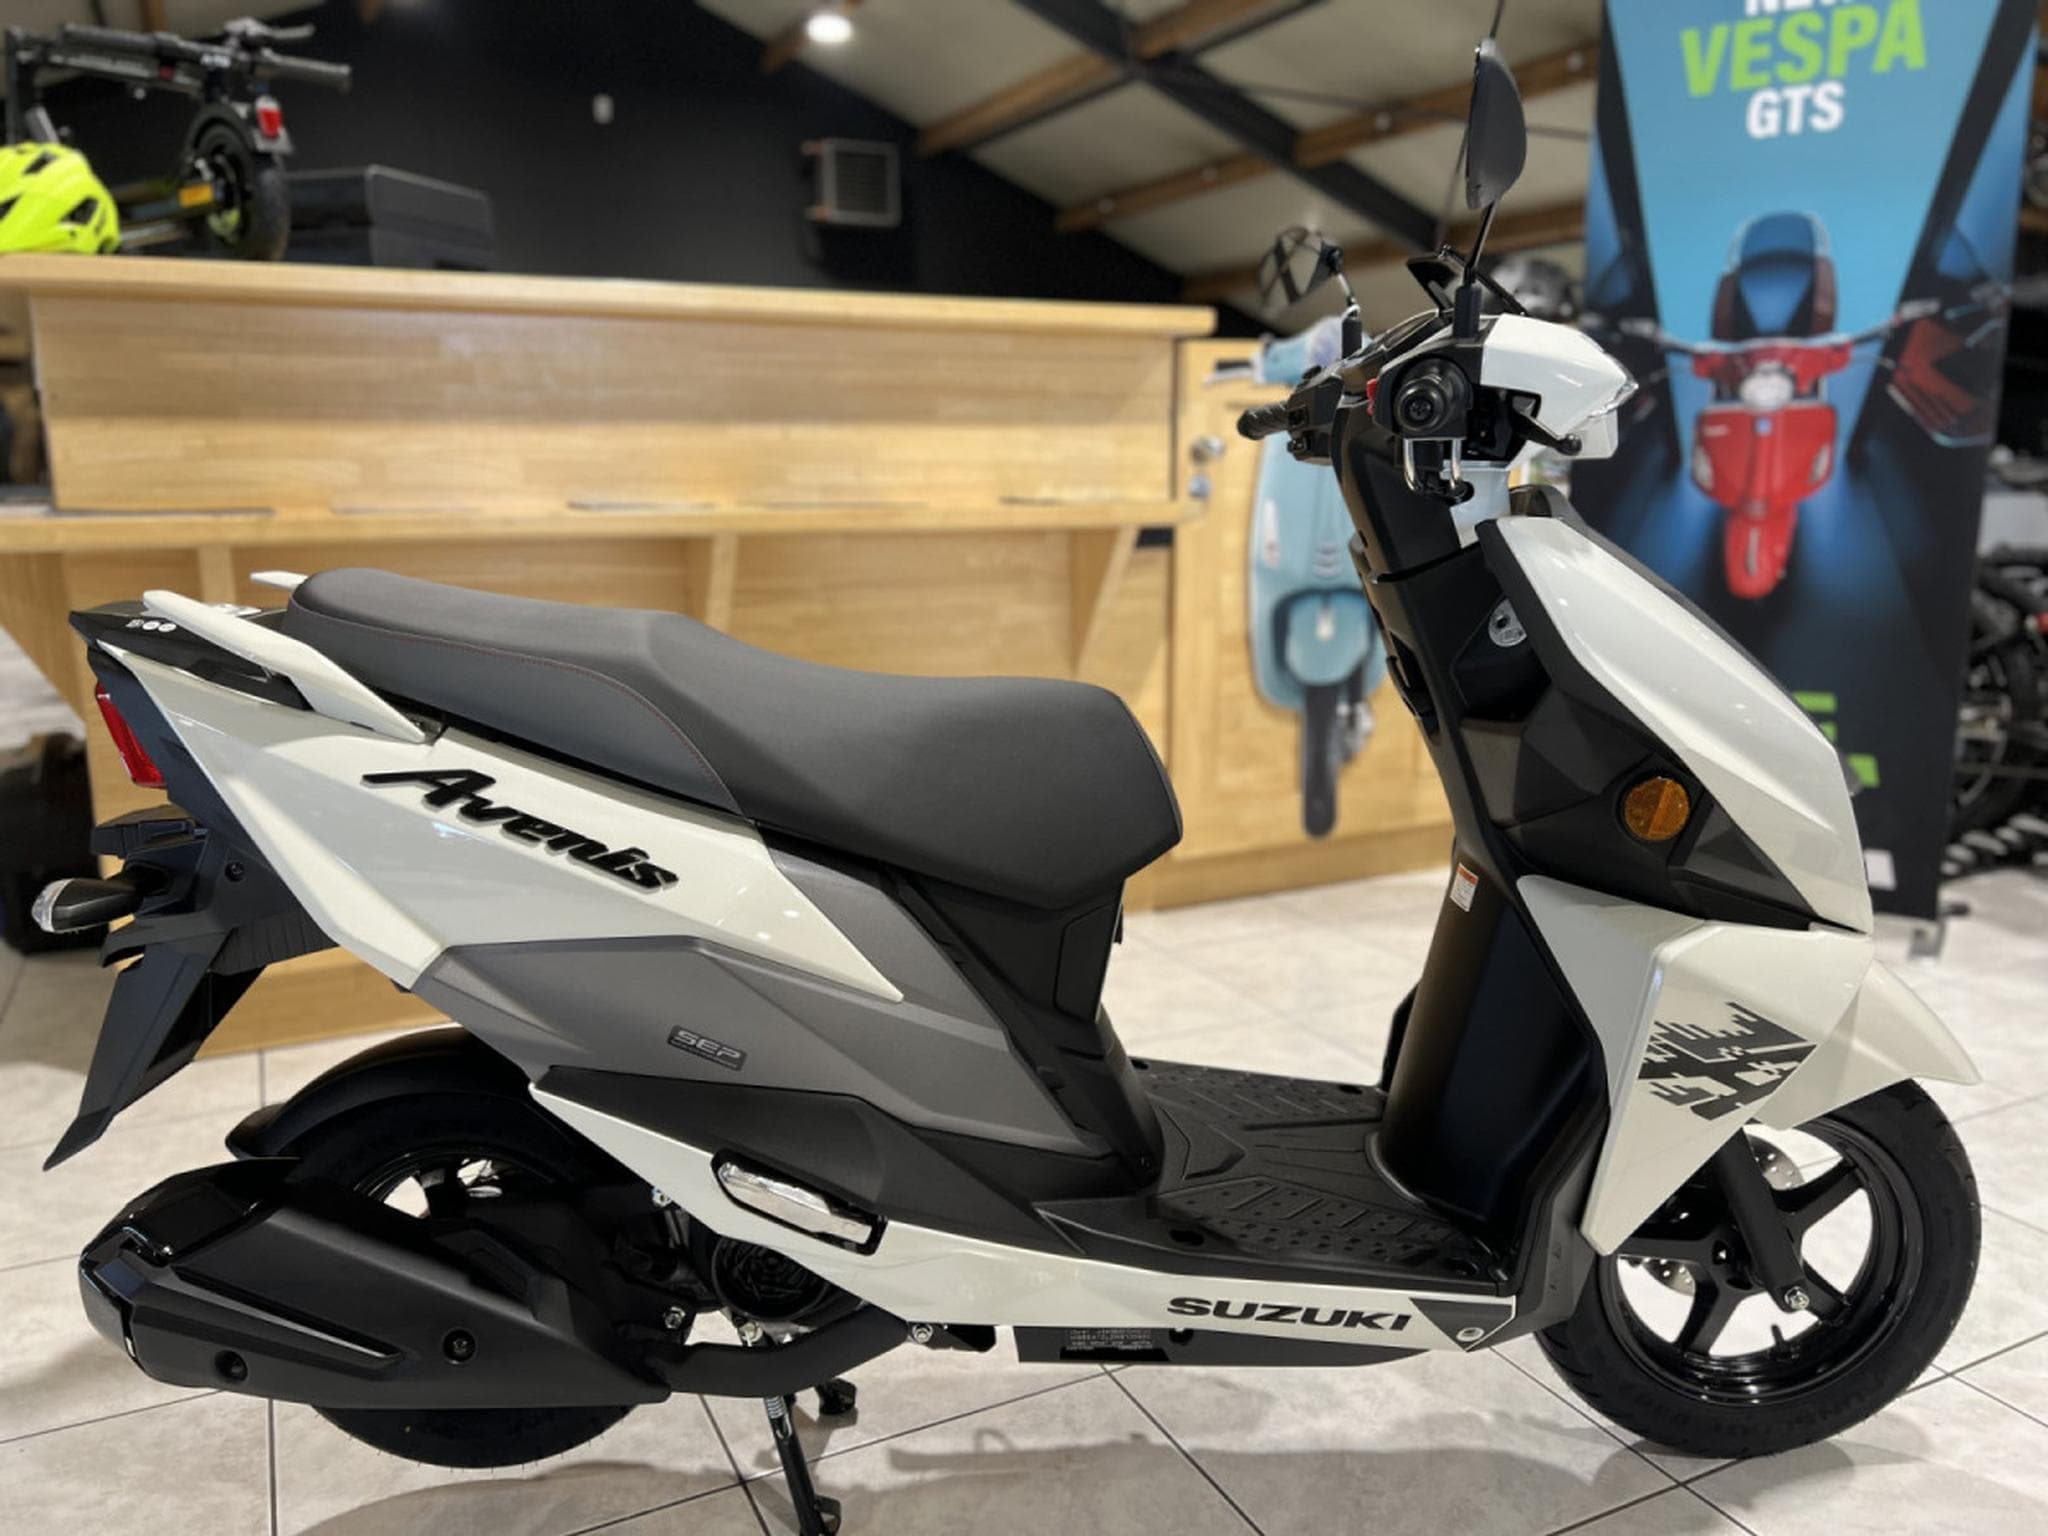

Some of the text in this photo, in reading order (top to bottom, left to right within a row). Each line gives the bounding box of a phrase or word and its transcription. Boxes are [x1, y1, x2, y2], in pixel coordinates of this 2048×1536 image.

[1680, 0, 1927, 97] VESPA
[1746, 80, 1845, 139] GTS
[361, 768, 680, 891] Avenis
[674, 1030, 742, 1059] SEP
[1167, 1297, 1412, 1331] SUZUKI
